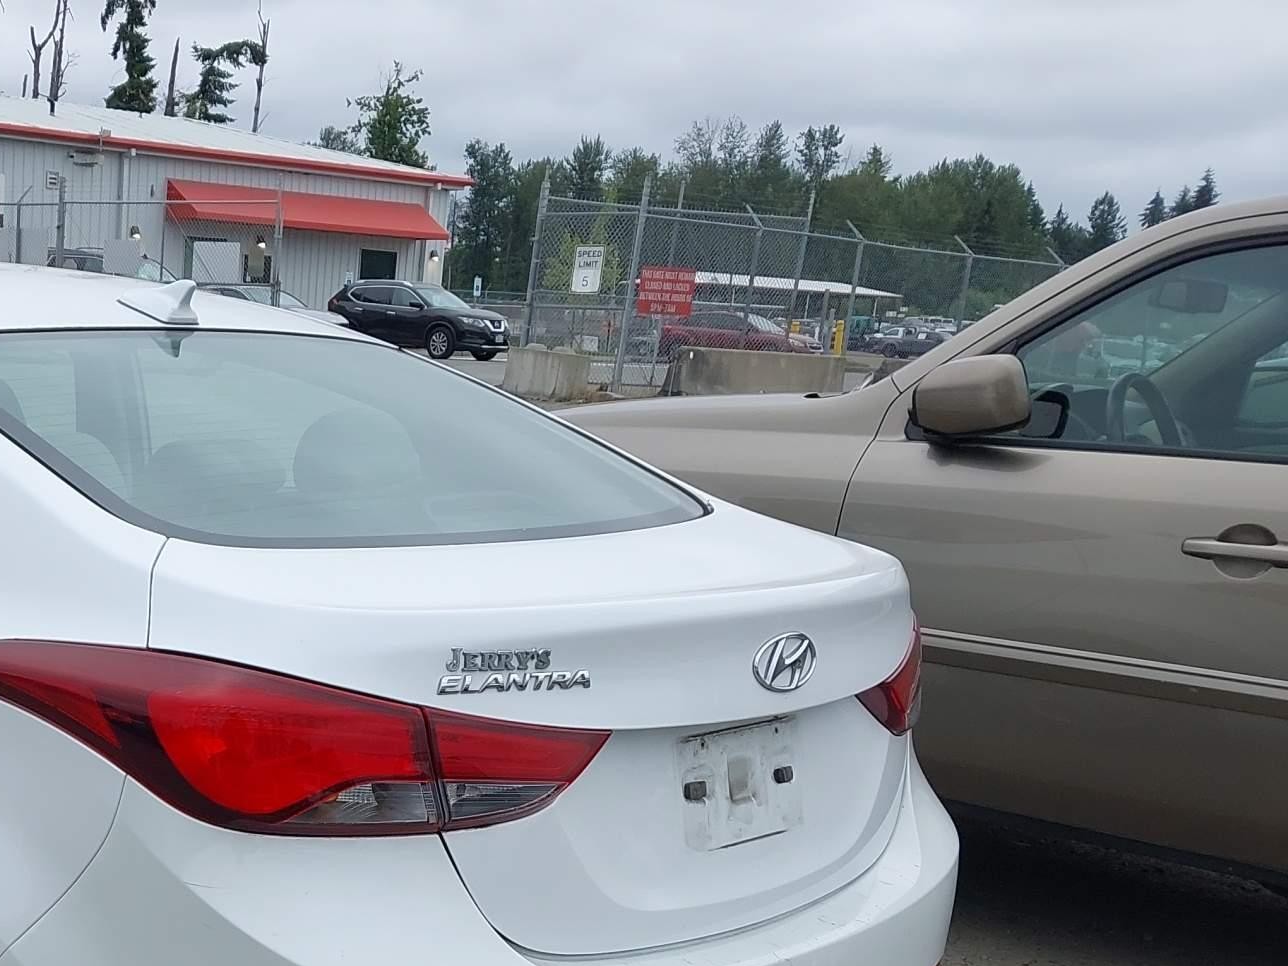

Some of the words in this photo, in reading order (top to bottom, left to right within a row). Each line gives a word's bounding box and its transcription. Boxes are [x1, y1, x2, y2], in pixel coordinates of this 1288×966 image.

[577, 250, 602, 258] SPEED
[578, 260, 599, 268] LIMIT
[581, 275, 589, 287] 5
[437, 670, 591, 695] ELANTRA
